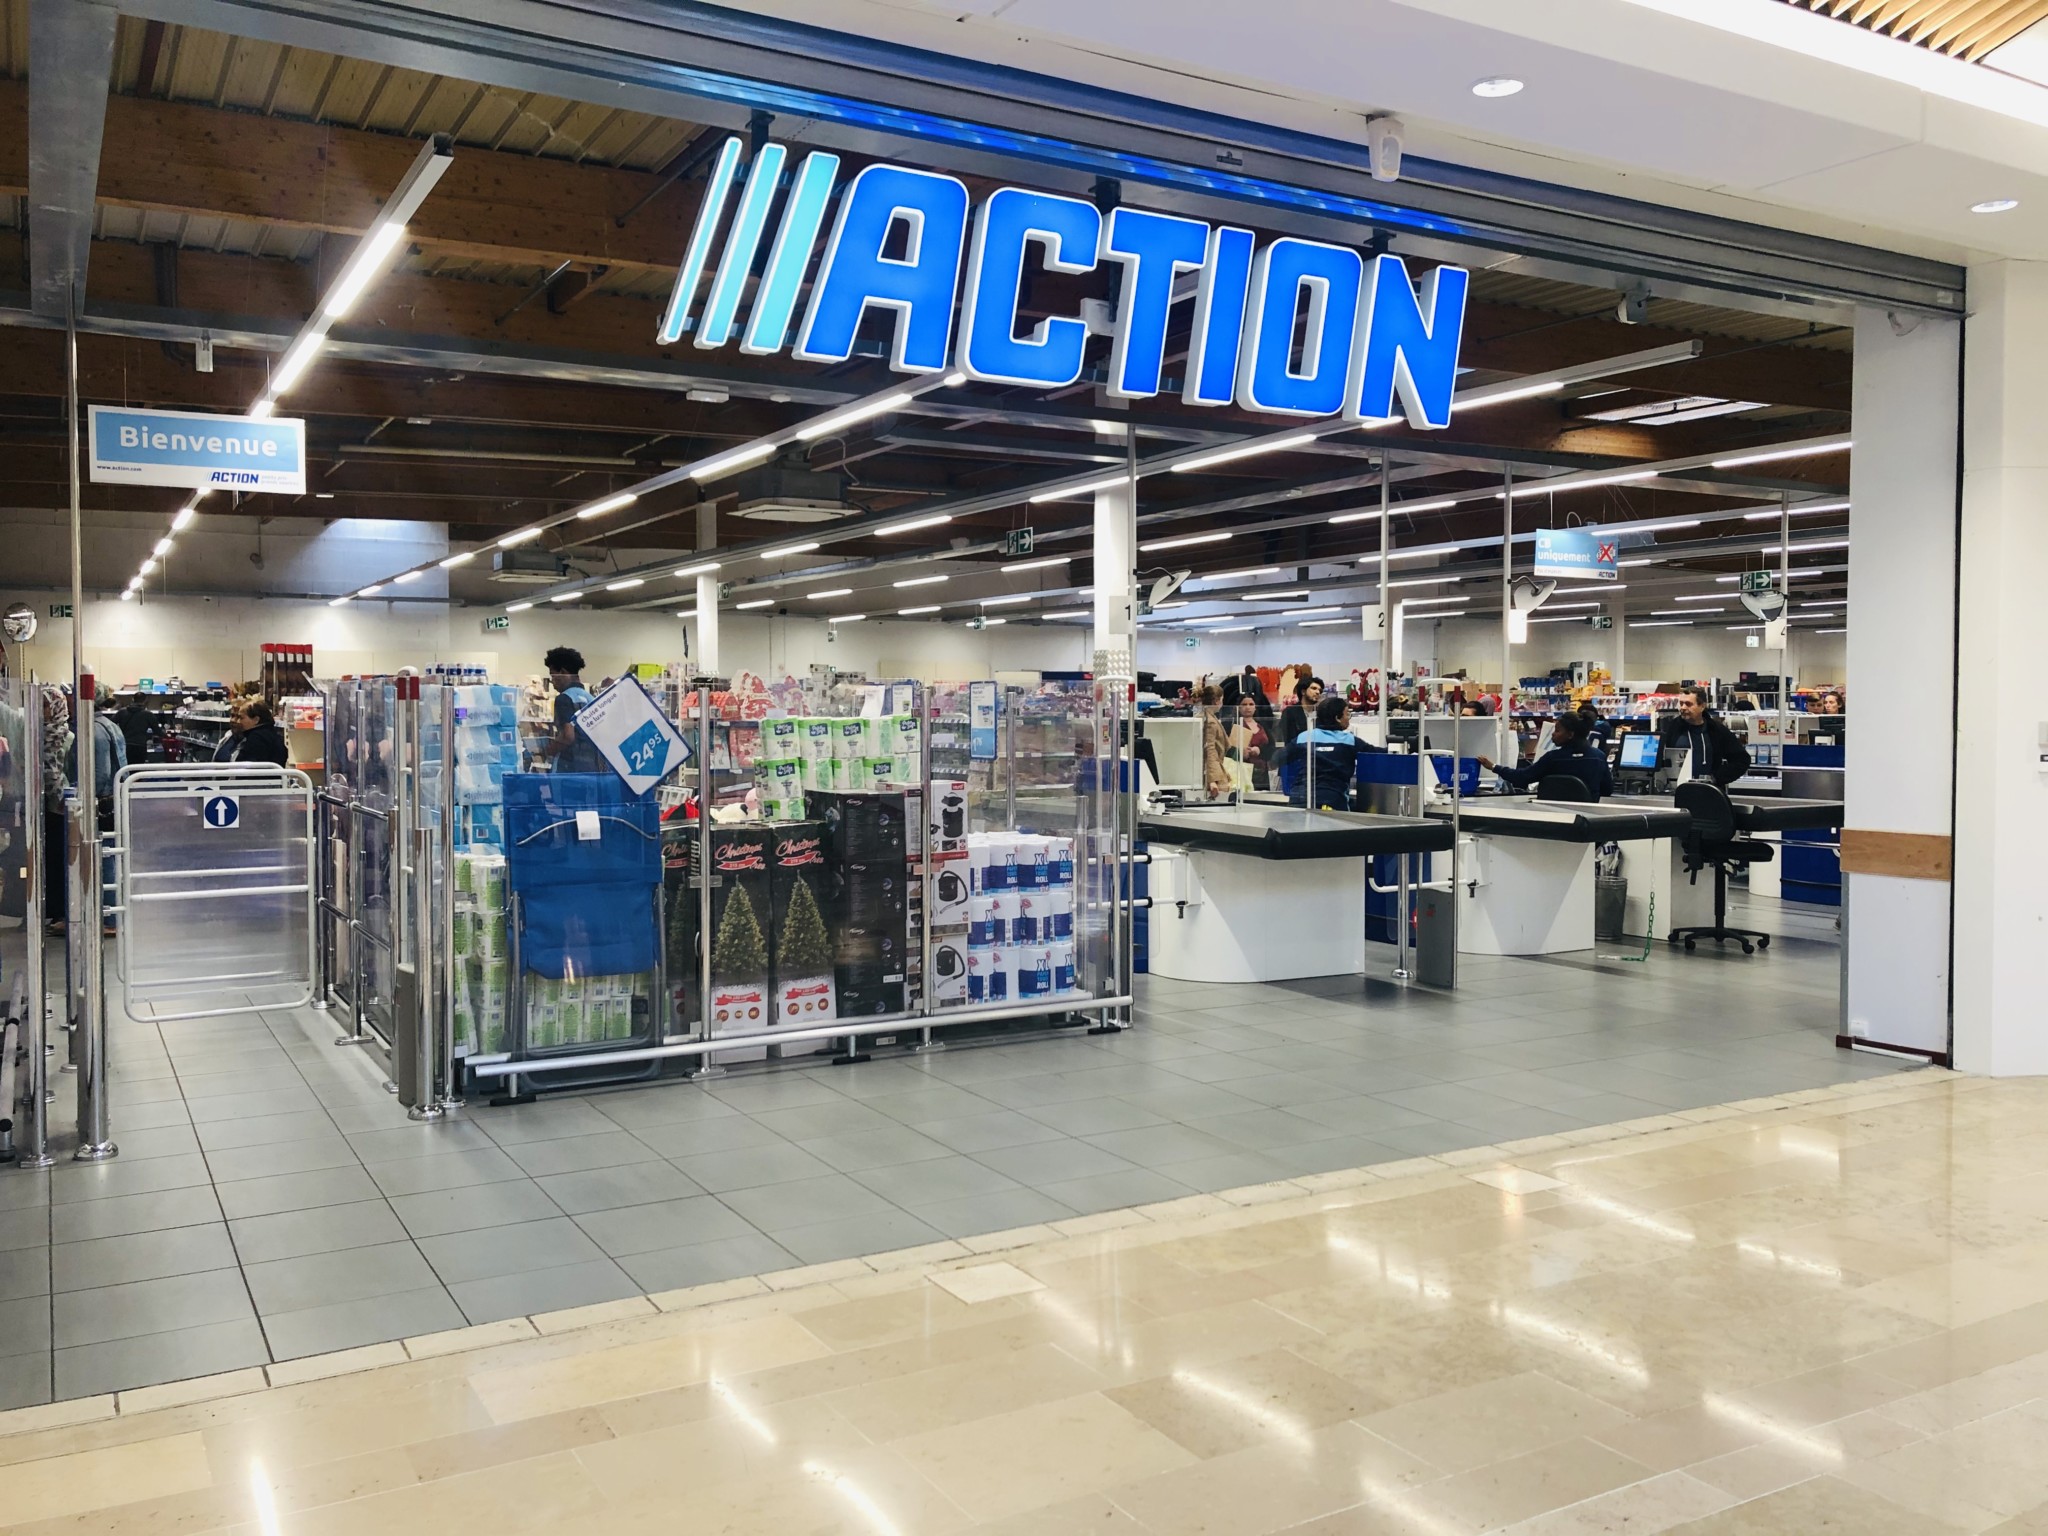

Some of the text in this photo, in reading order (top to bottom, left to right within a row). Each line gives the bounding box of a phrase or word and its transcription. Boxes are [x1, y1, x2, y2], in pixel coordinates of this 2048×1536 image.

[793, 162, 1470, 430] ACTION
[119, 425, 278, 457] Bienvenue
[210, 471, 259, 484] ACTION
[1537, 549, 1591, 562] uniquement
[1124, 604, 1131, 621] 1
[1378, 611, 1385, 628] 2
[1035, 875, 1049, 883] ROLL
